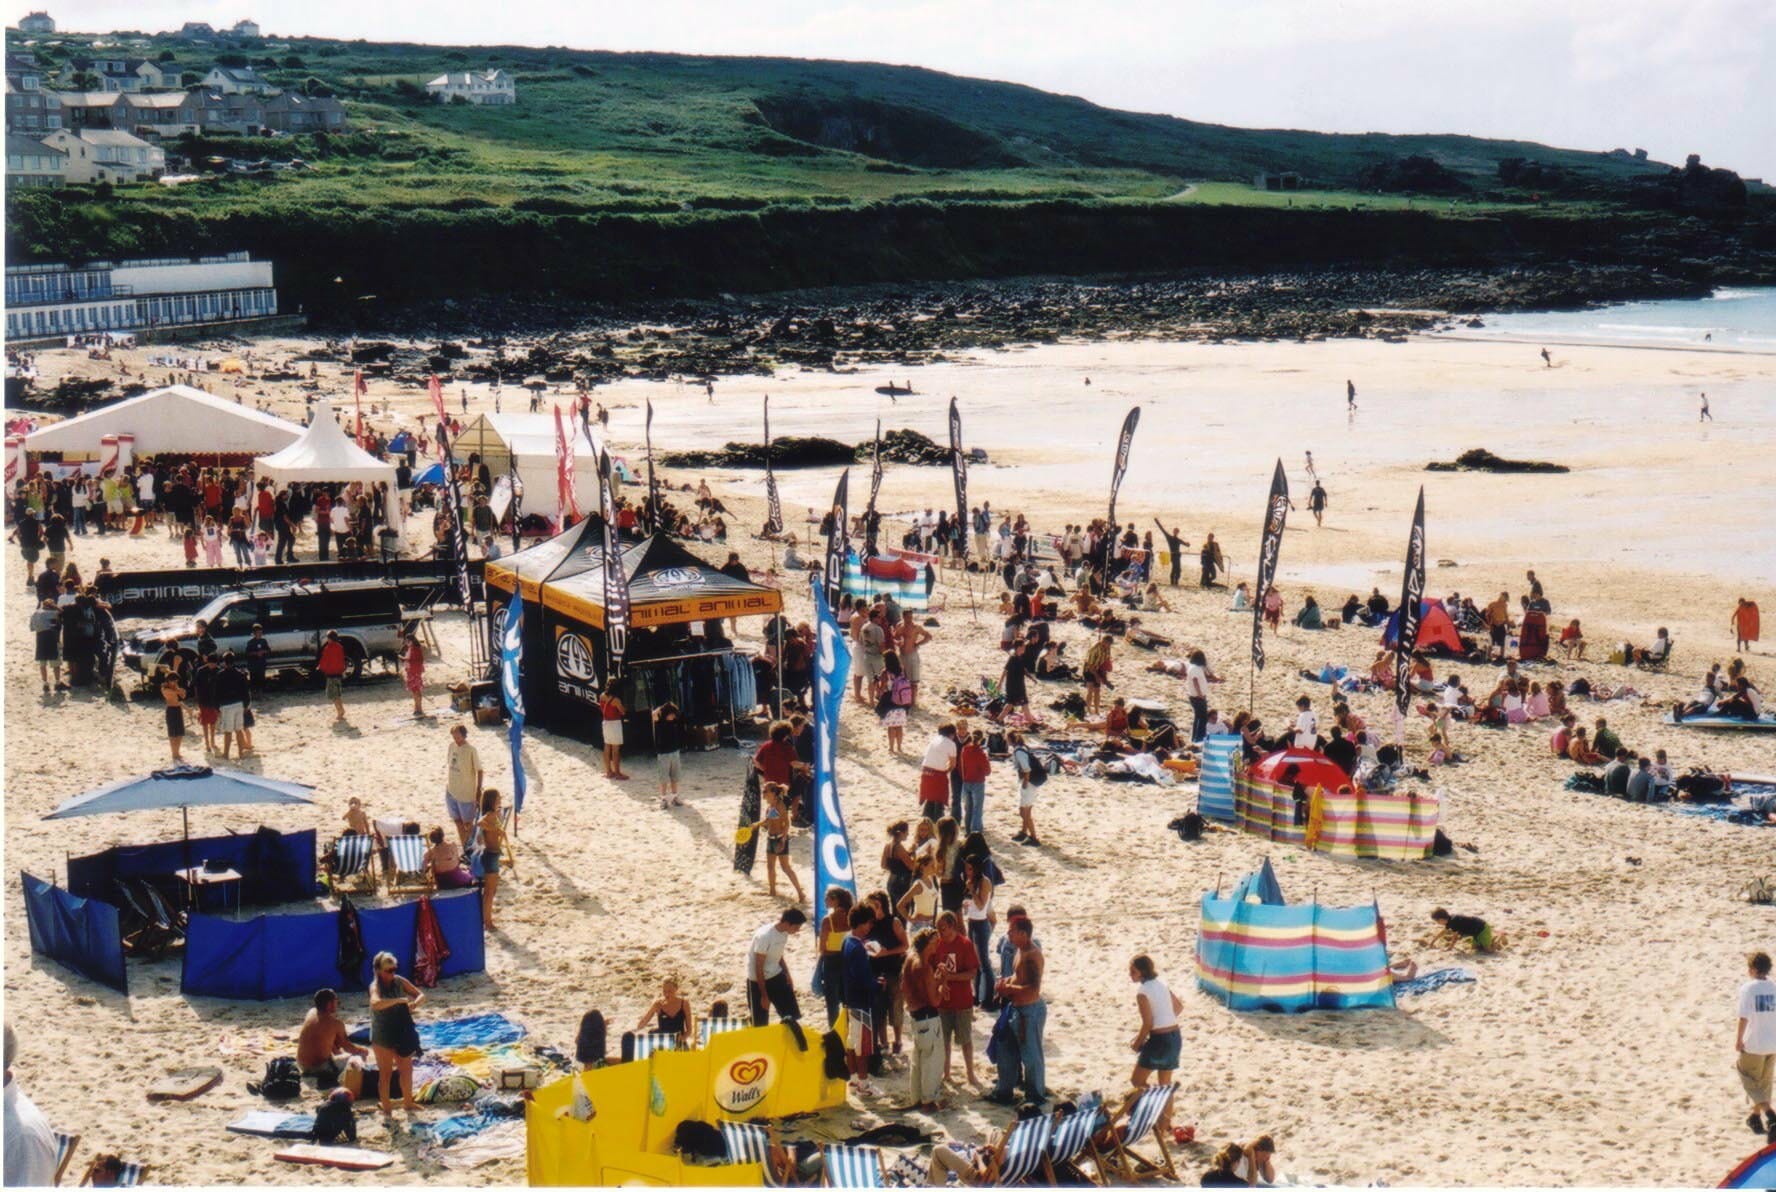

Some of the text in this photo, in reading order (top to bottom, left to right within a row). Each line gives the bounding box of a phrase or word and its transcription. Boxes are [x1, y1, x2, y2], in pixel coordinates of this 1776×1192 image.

[123, 584, 212, 600] animal
[631, 597, 773, 619] nimal animal
